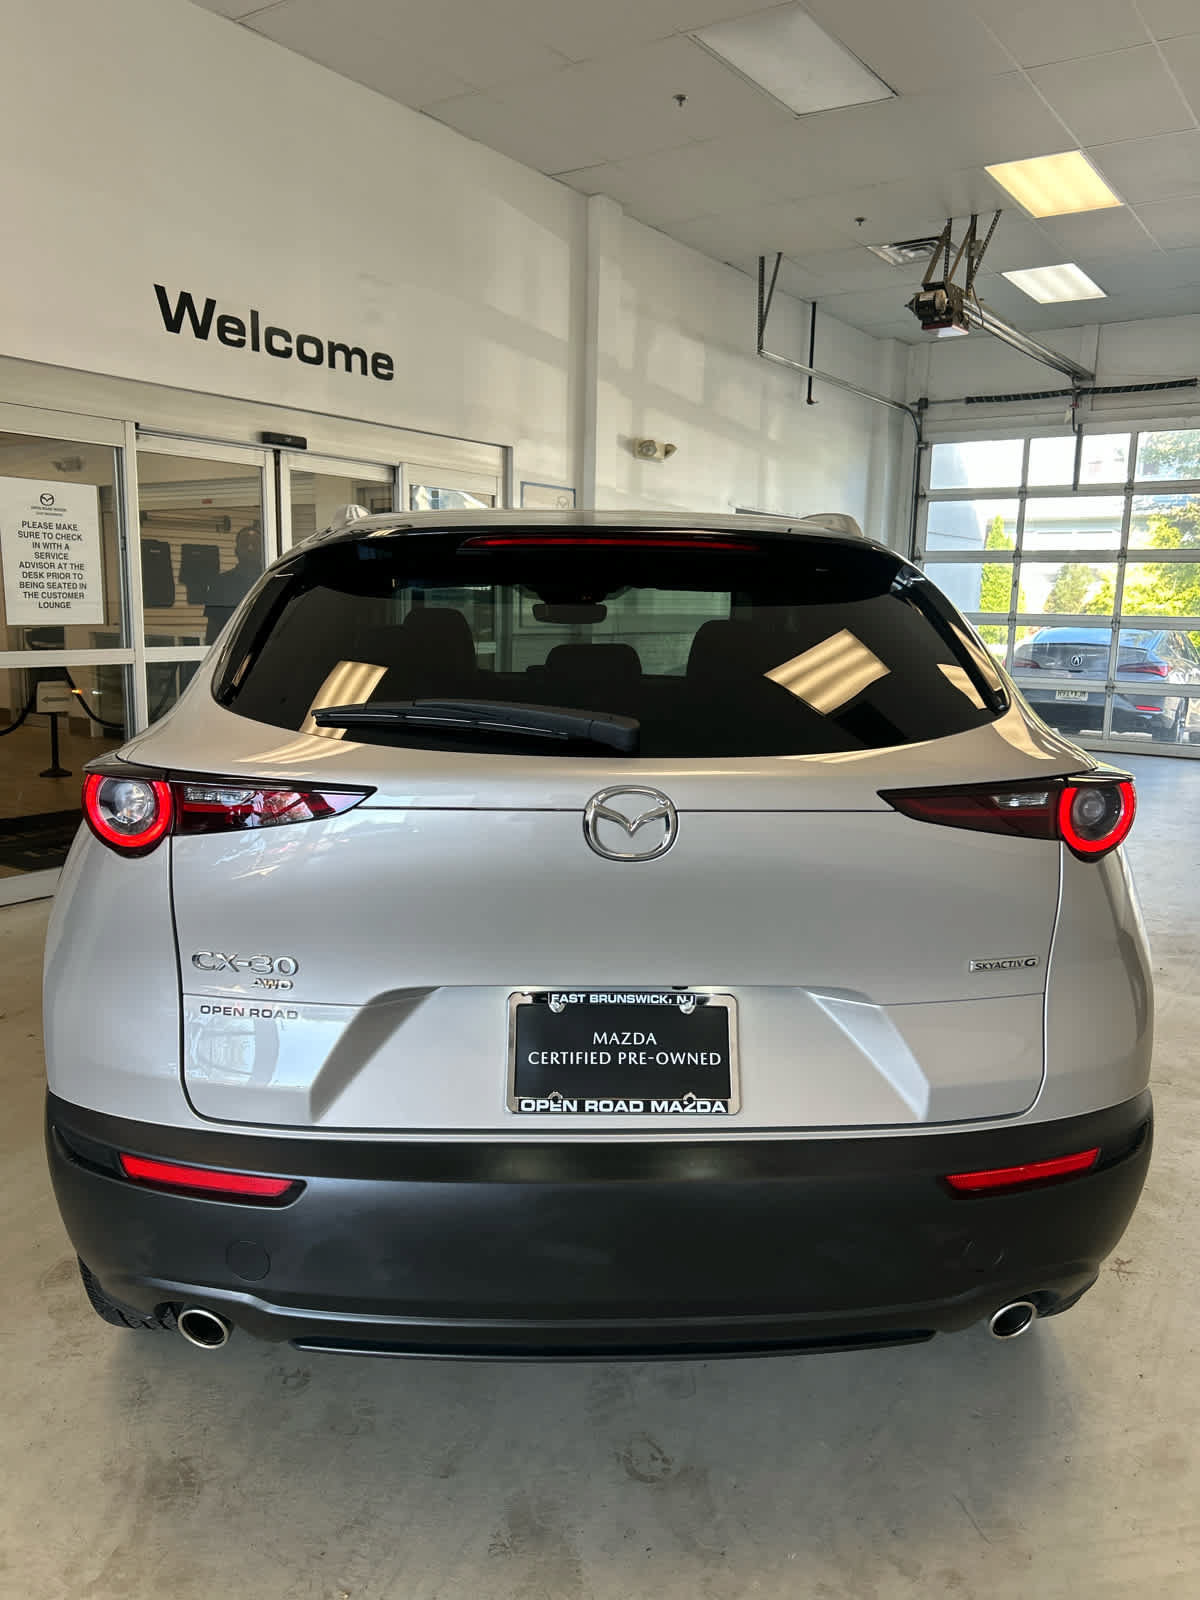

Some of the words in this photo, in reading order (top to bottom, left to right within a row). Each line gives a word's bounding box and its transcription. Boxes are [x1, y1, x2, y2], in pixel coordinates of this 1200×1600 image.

[153, 283, 394, 381] Welcome
[21, 520, 53, 530] PLEASE
[55, 522, 78, 531] MAKE
[17, 530, 40, 539] SURE
[42, 531, 53, 540] TO
[55, 532, 83, 541] CHECK
[42, 542, 63, 550] WITH
[64, 543, 70, 551] A
[34, 551, 69, 560] SERVICE
[19, 561, 55, 570] ADVISOR
[57, 562, 68, 570] AT
[70, 563, 85, 571] THE
[22, 571, 45, 579] DESK
[46, 572, 71, 580] PRIOR
[19, 581, 45, 590] BEING
[46, 582, 78, 590] SEATED
[79, 582, 87, 590] IN
[23, 591, 39, 599] THE
[41, 591, 85, 599] CUSTOMER
[38, 601, 71, 609] LOUNGE
[191, 950, 299, 977] CX-30
[975, 960, 1023, 971] SKYACTIV
[1024, 958, 1037, 967] G
[250, 977, 293, 991] AWD
[551, 993, 586, 1004] EAST
[589, 993, 672, 1005] BRUNSWICK,
[200, 1004, 245, 1017] OPEN
[249, 1008, 299, 1020] ROAD
[592, 1032, 657, 1046] MAZDA
[528, 1051, 612, 1066] CERTIFIED
[618, 1051, 722, 1066] PRE-OWNED
[520, 1099, 578, 1113] OPEN
[584, 1100, 644, 1113] ROAD
[650, 1100, 727, 1113] MAZDA
